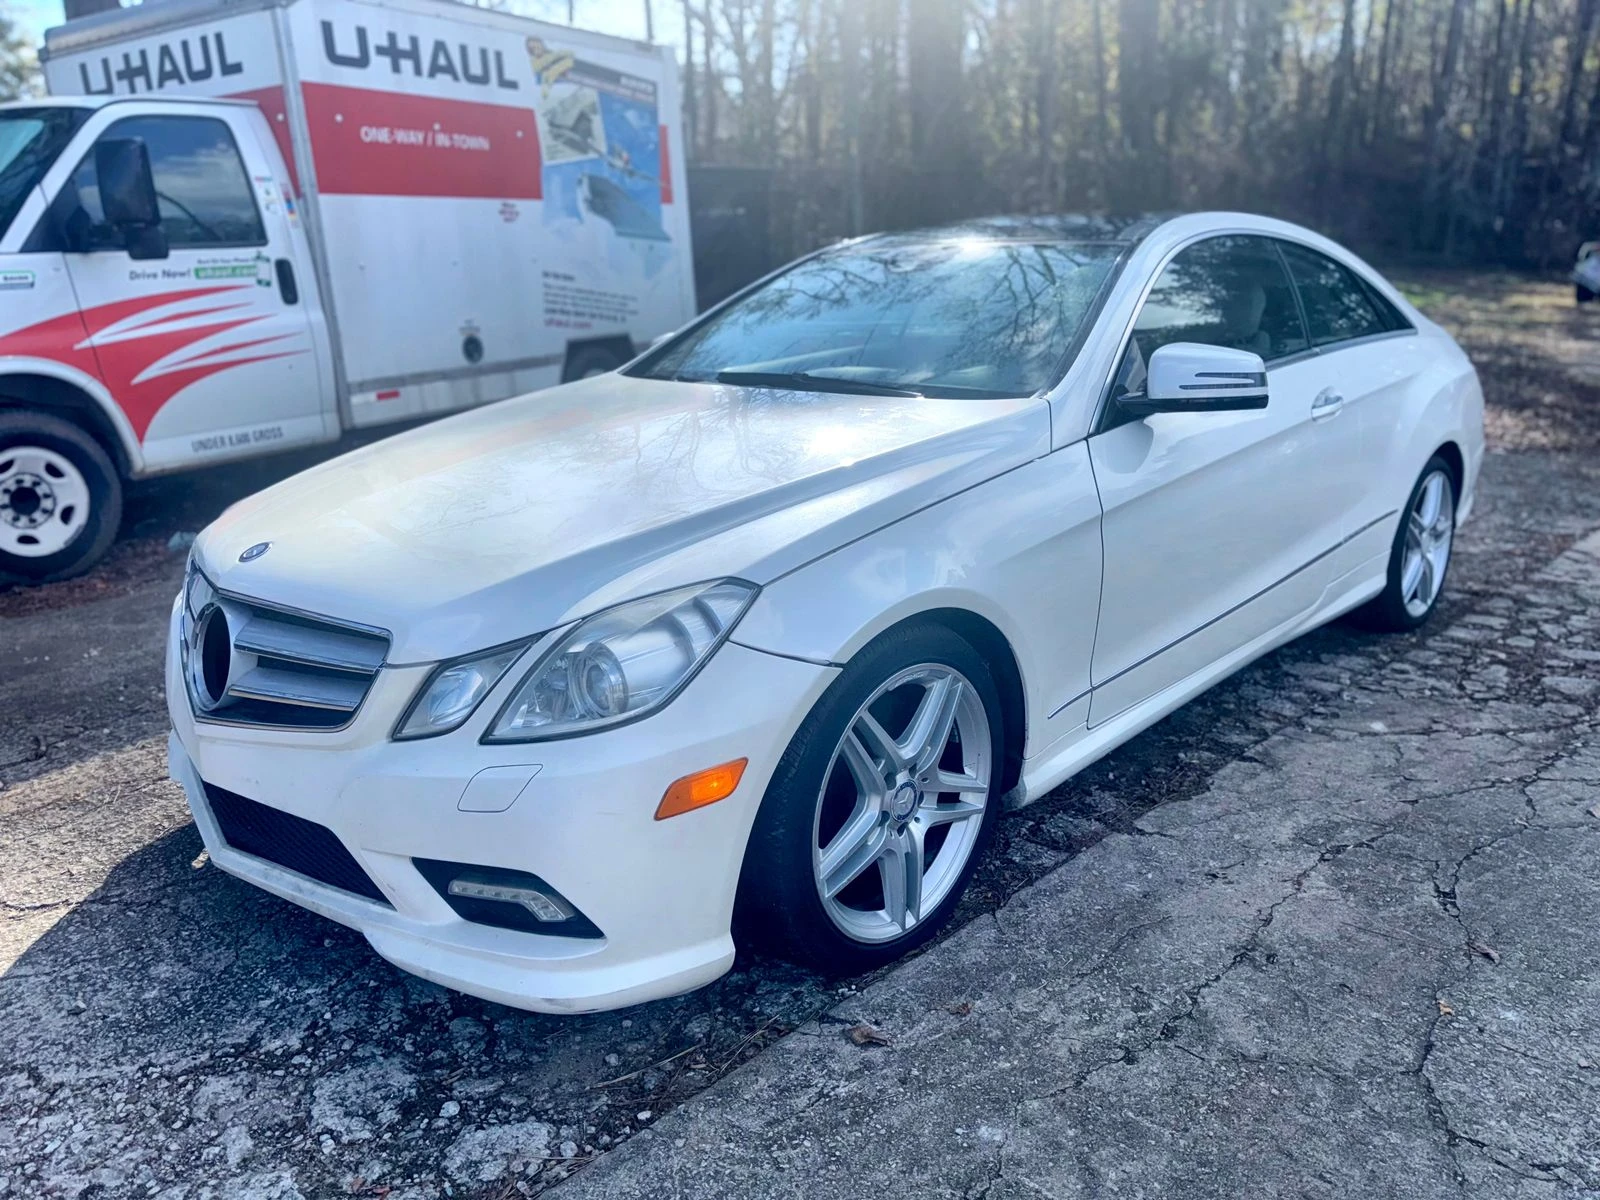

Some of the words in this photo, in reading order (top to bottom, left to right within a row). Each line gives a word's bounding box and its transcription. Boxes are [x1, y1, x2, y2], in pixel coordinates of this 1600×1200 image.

[360, 126, 424, 145] ONE-WAY
[434, 132, 490, 151] IN-TOWN
[129, 269, 158, 281] Drive
[161, 268, 191, 279] Now!
[191, 435, 226, 453] UNDER
[252, 426, 284, 442] GROSS
